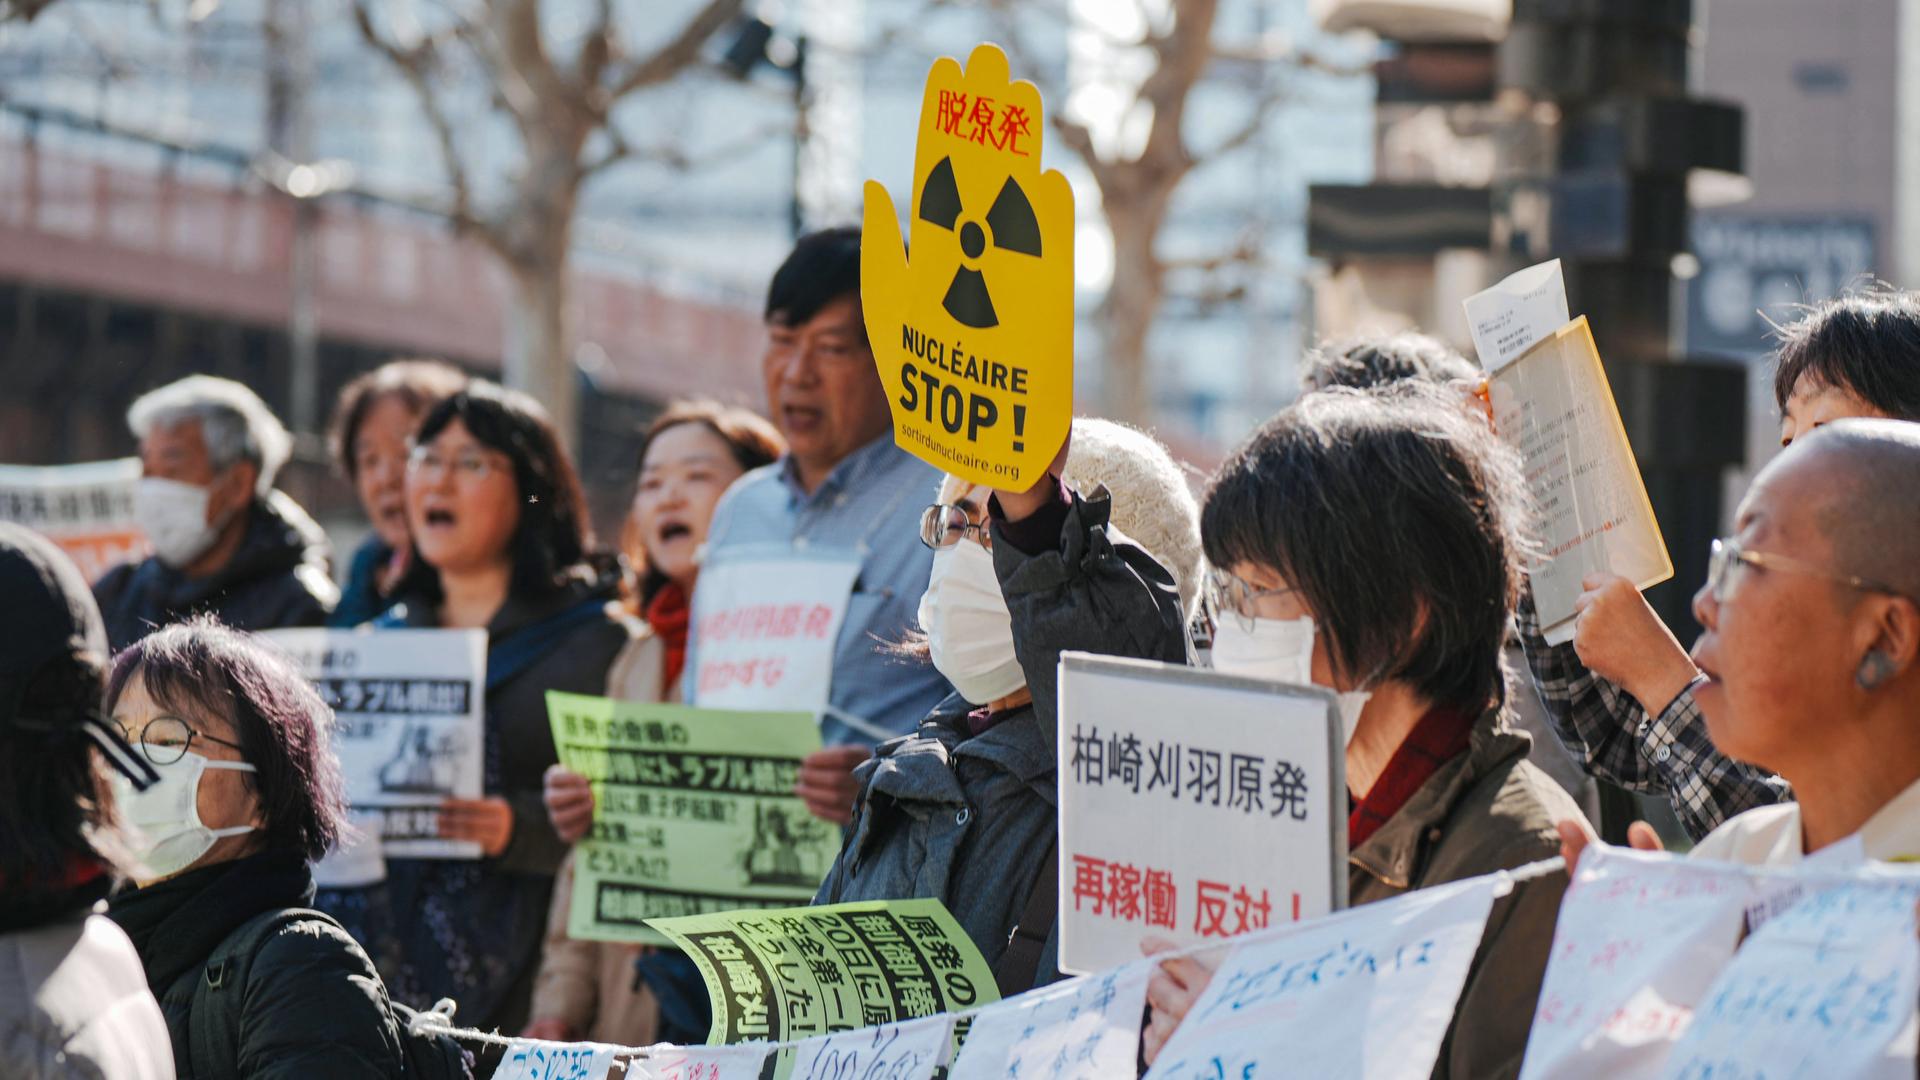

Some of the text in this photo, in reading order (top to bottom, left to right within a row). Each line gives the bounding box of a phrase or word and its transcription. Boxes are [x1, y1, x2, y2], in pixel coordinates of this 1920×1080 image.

[936, 89, 1032, 157] 脱原発
[902, 323, 1028, 395] NUCLÉAIRE
[901, 423, 1020, 481] sortirdunucleaire.org
[1071, 723, 1308, 821] 柏崎刈羽原発
[1072, 853, 1177, 931] 再稼働
[736, 921, 817, 1038] どうした!
